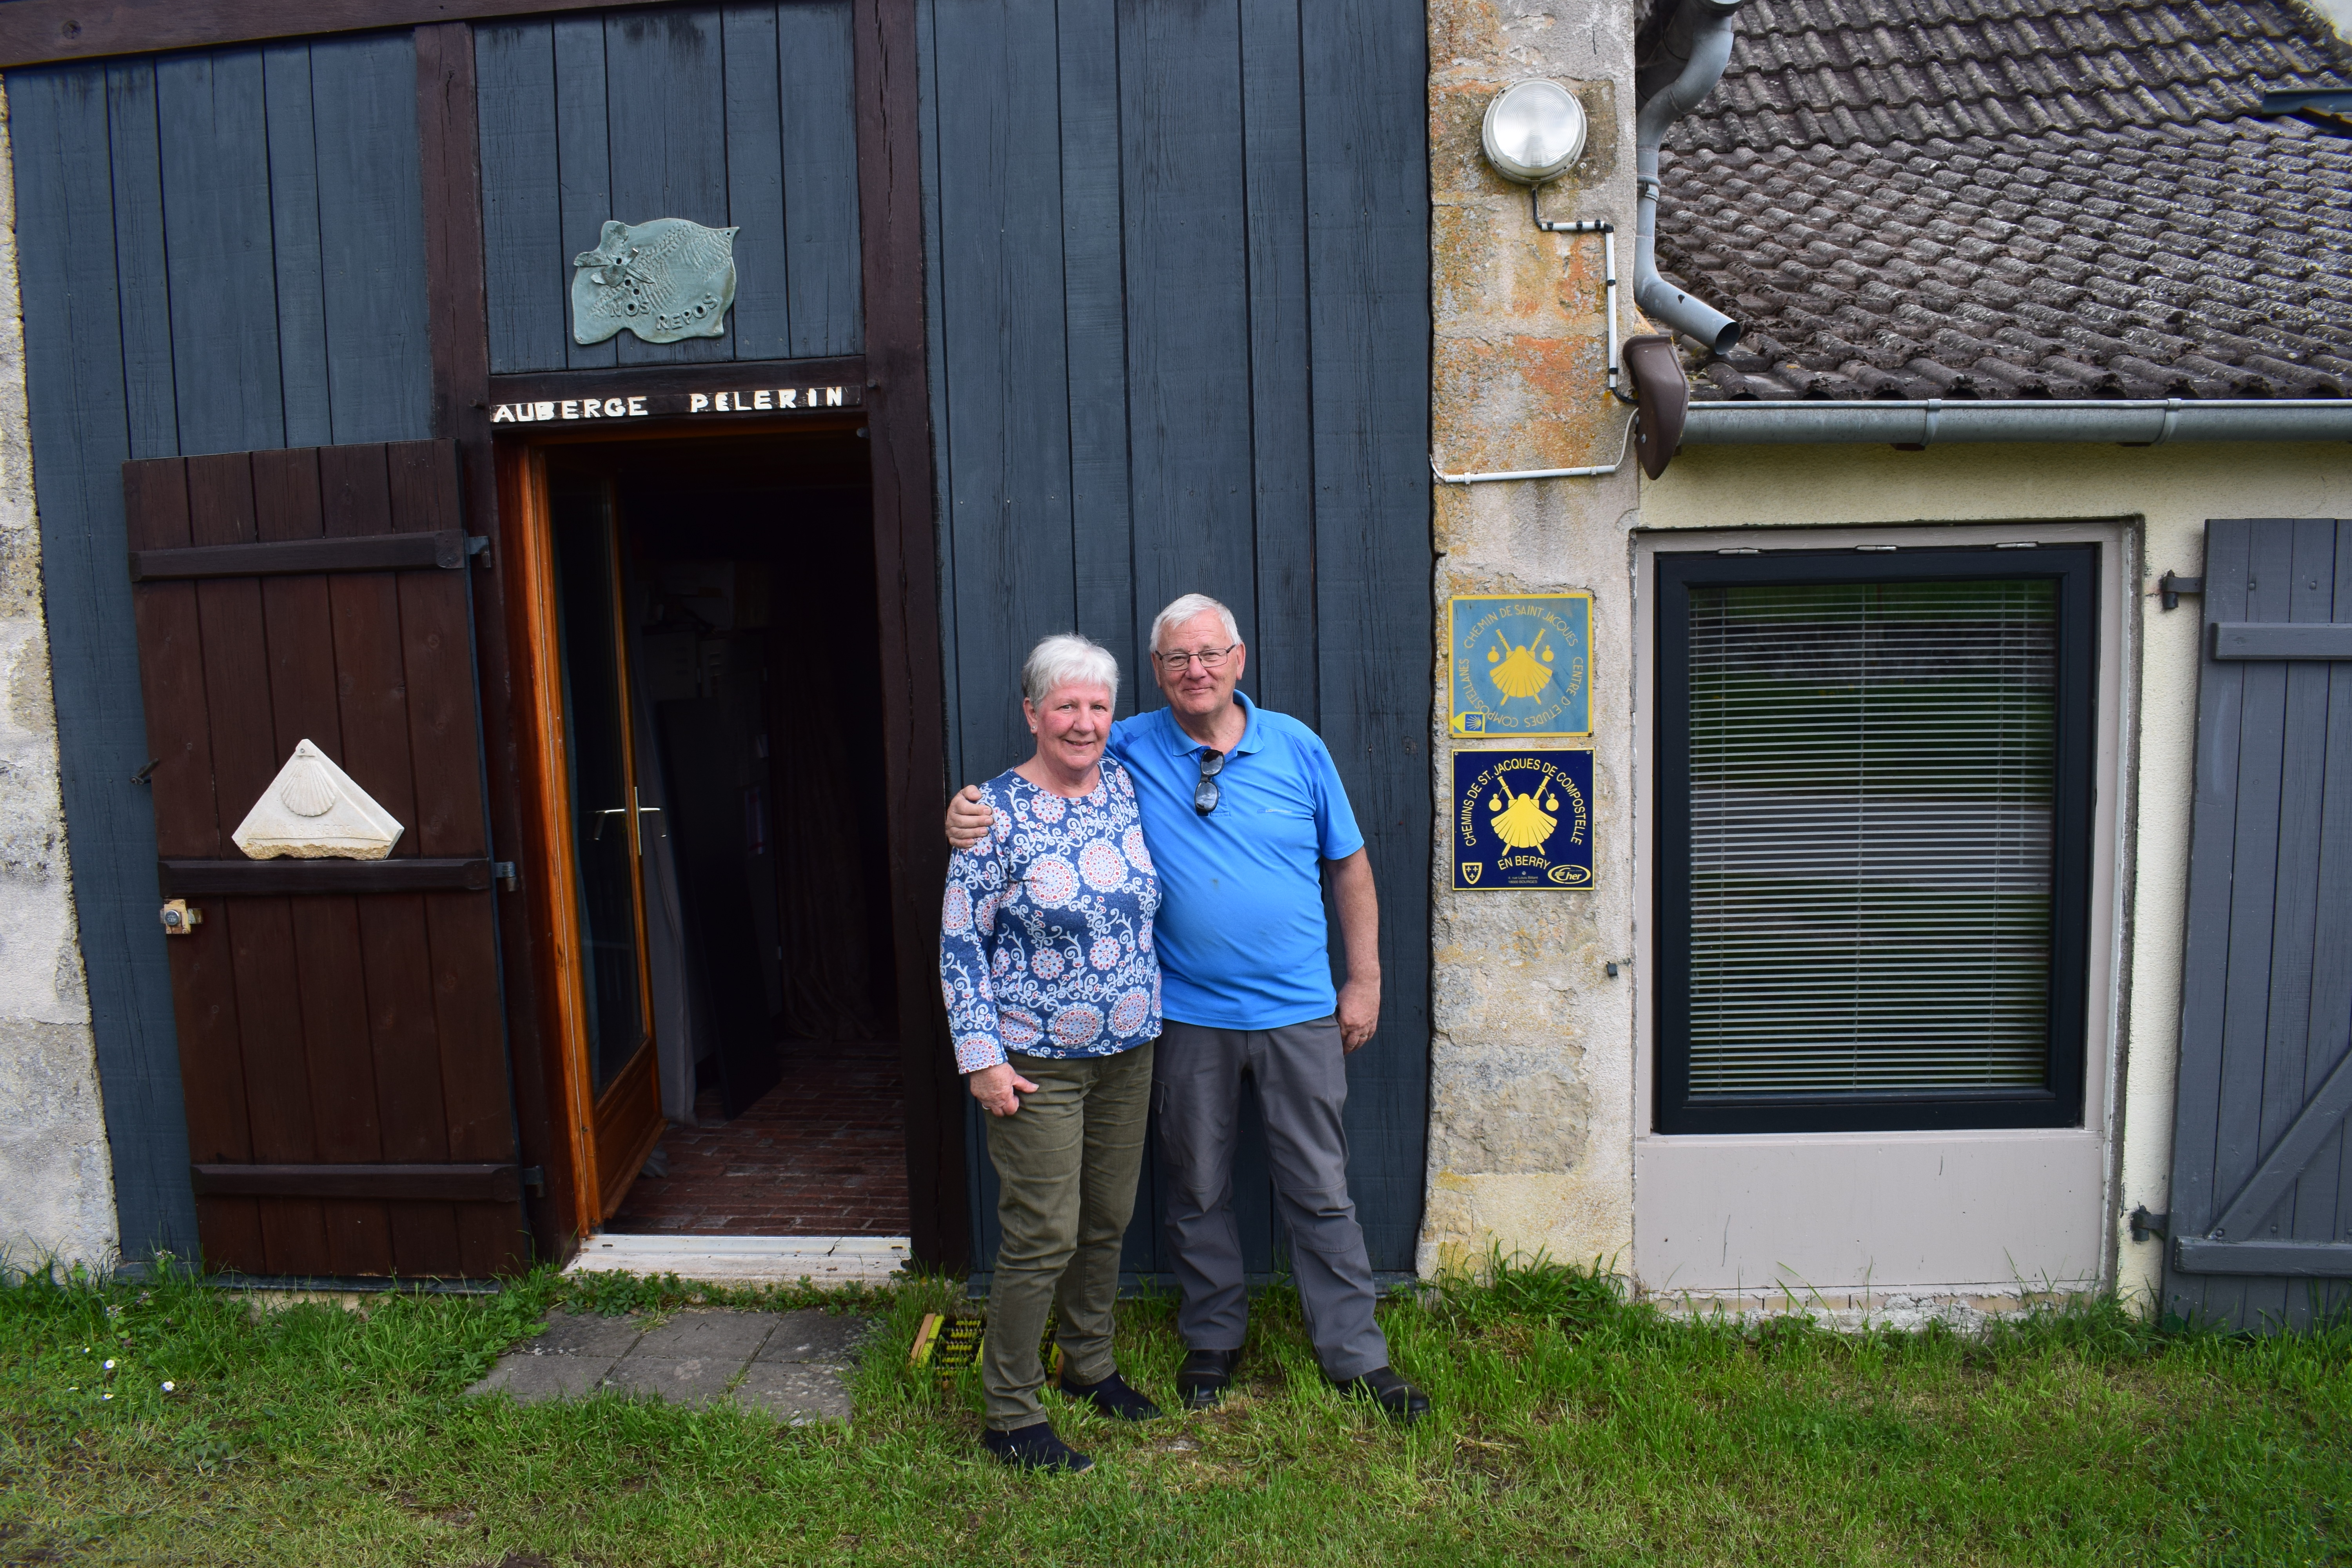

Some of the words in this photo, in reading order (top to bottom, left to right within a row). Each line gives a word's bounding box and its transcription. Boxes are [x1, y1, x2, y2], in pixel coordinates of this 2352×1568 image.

[609, 300, 650, 317] NOS
[656, 292, 719, 330] REPOS
[494, 396, 648, 422] AUBERGE
[1464, 612, 1499, 649] CHEMIN
[1499, 606, 1512, 618] DE
[1515, 605, 1544, 617] SAINT
[1542, 612, 1578, 646] JACQUES
[1566, 657, 1583, 697] CENTRE
[1459, 659, 1519, 728] COMPOSTELLANES
[1478, 770, 1494, 786] ST.
[1494, 758, 1541, 776] JACQUES
[1542, 762, 1558, 777] DE
[1467, 782, 1482, 799] DE
[1556, 772, 1586, 845] COMPOSTELLE
[1461, 799, 1477, 846] CHEMINS
[1497, 857, 1513, 870] EN
[1515, 855, 1551, 870] BERRY
[1555, 867, 1582, 880] Cher
